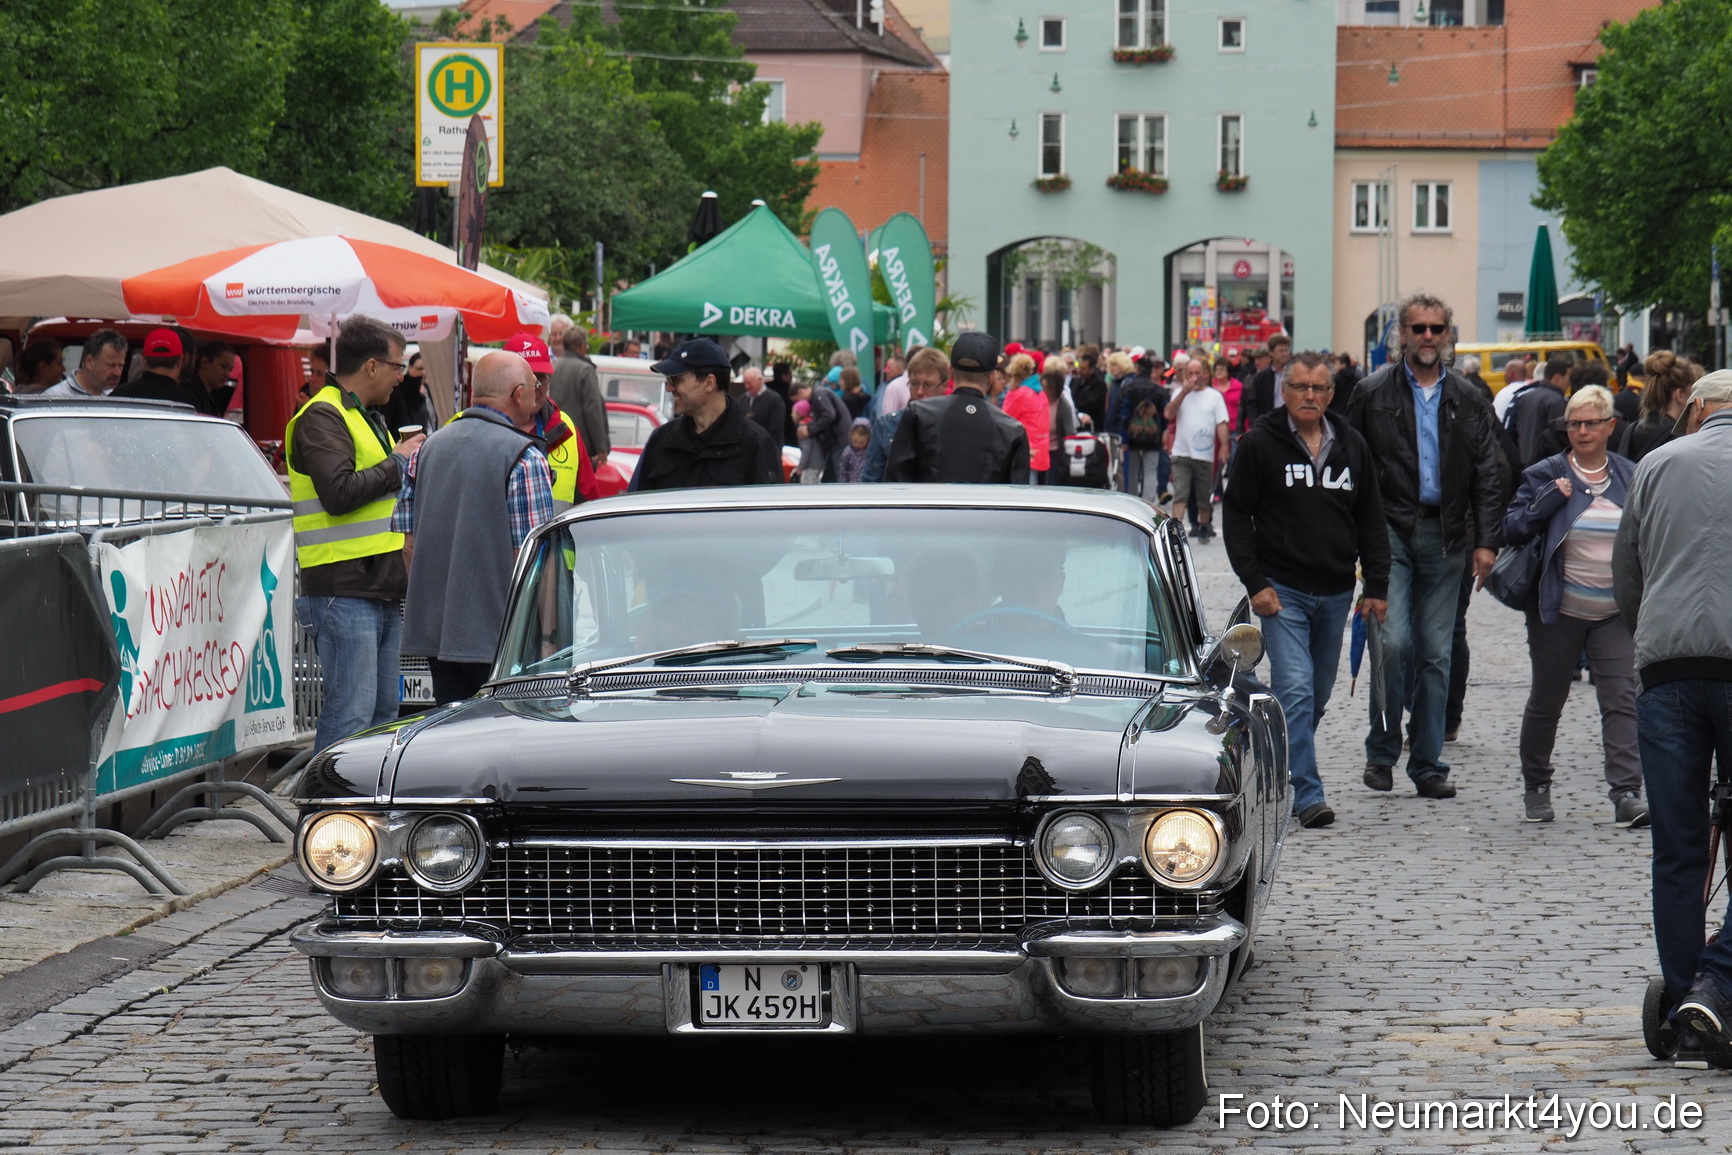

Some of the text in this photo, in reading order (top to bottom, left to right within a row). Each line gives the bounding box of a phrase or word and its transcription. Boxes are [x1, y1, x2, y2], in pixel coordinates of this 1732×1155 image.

[445, 69, 475, 103] H
[438, 126, 468, 135] Ratha
[247, 286, 341, 296] württembergische
[730, 306, 796, 328] DEKRA
[1285, 464, 1353, 491] FILA
[404, 678, 422, 698] NM
[707, 981, 714, 989] D
[745, 967, 761, 991] N
[706, 995, 816, 1019] JK 459H
